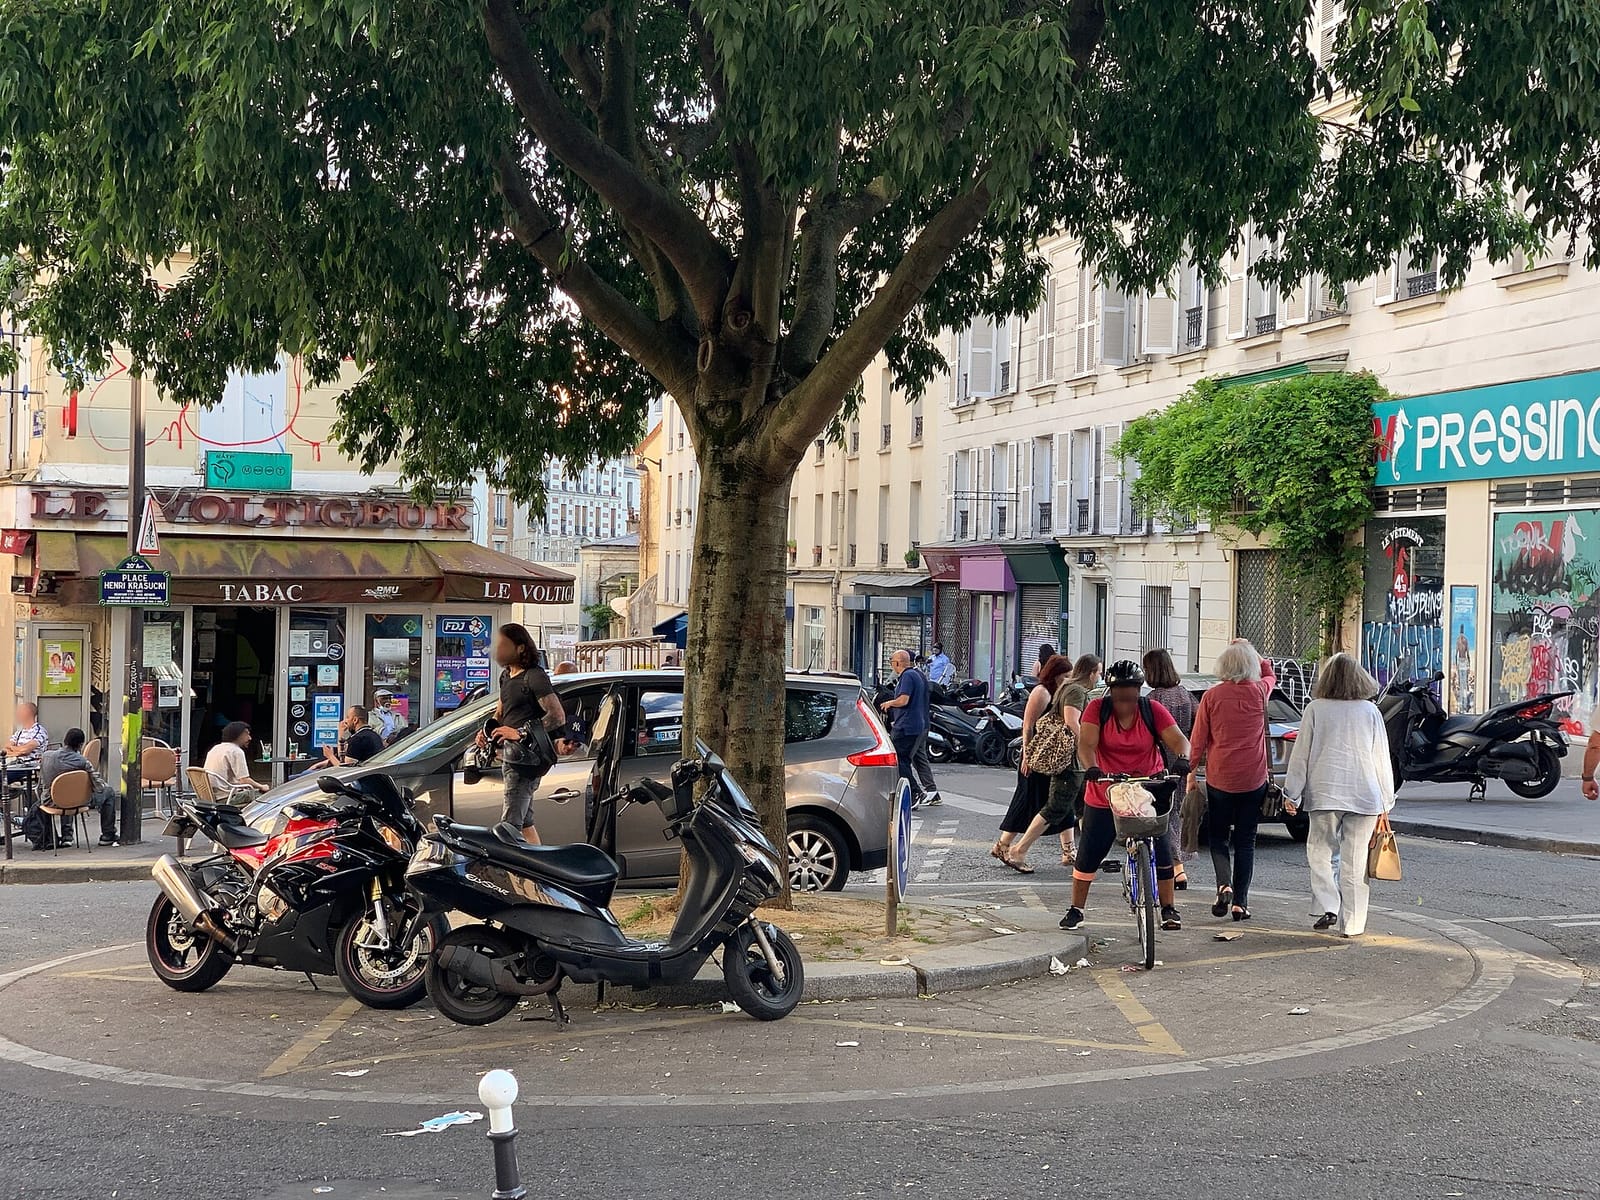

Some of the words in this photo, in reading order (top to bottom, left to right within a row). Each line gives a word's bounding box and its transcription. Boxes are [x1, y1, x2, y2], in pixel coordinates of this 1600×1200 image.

[31, 491, 108, 520] LE
[148, 491, 470, 530] VOLTIGEUR
[1381, 535, 1391, 550] LE
[1083, 554, 1094, 562] 107
[122, 574, 148, 582] PLACE
[104, 582, 126, 590] HENRI
[128, 582, 166, 590] KRASUCKI
[376, 586, 399, 595] PMU
[483, 581, 511, 599] LE
[219, 584, 303, 602] TABAC
[445, 621, 466, 631] FDJ
